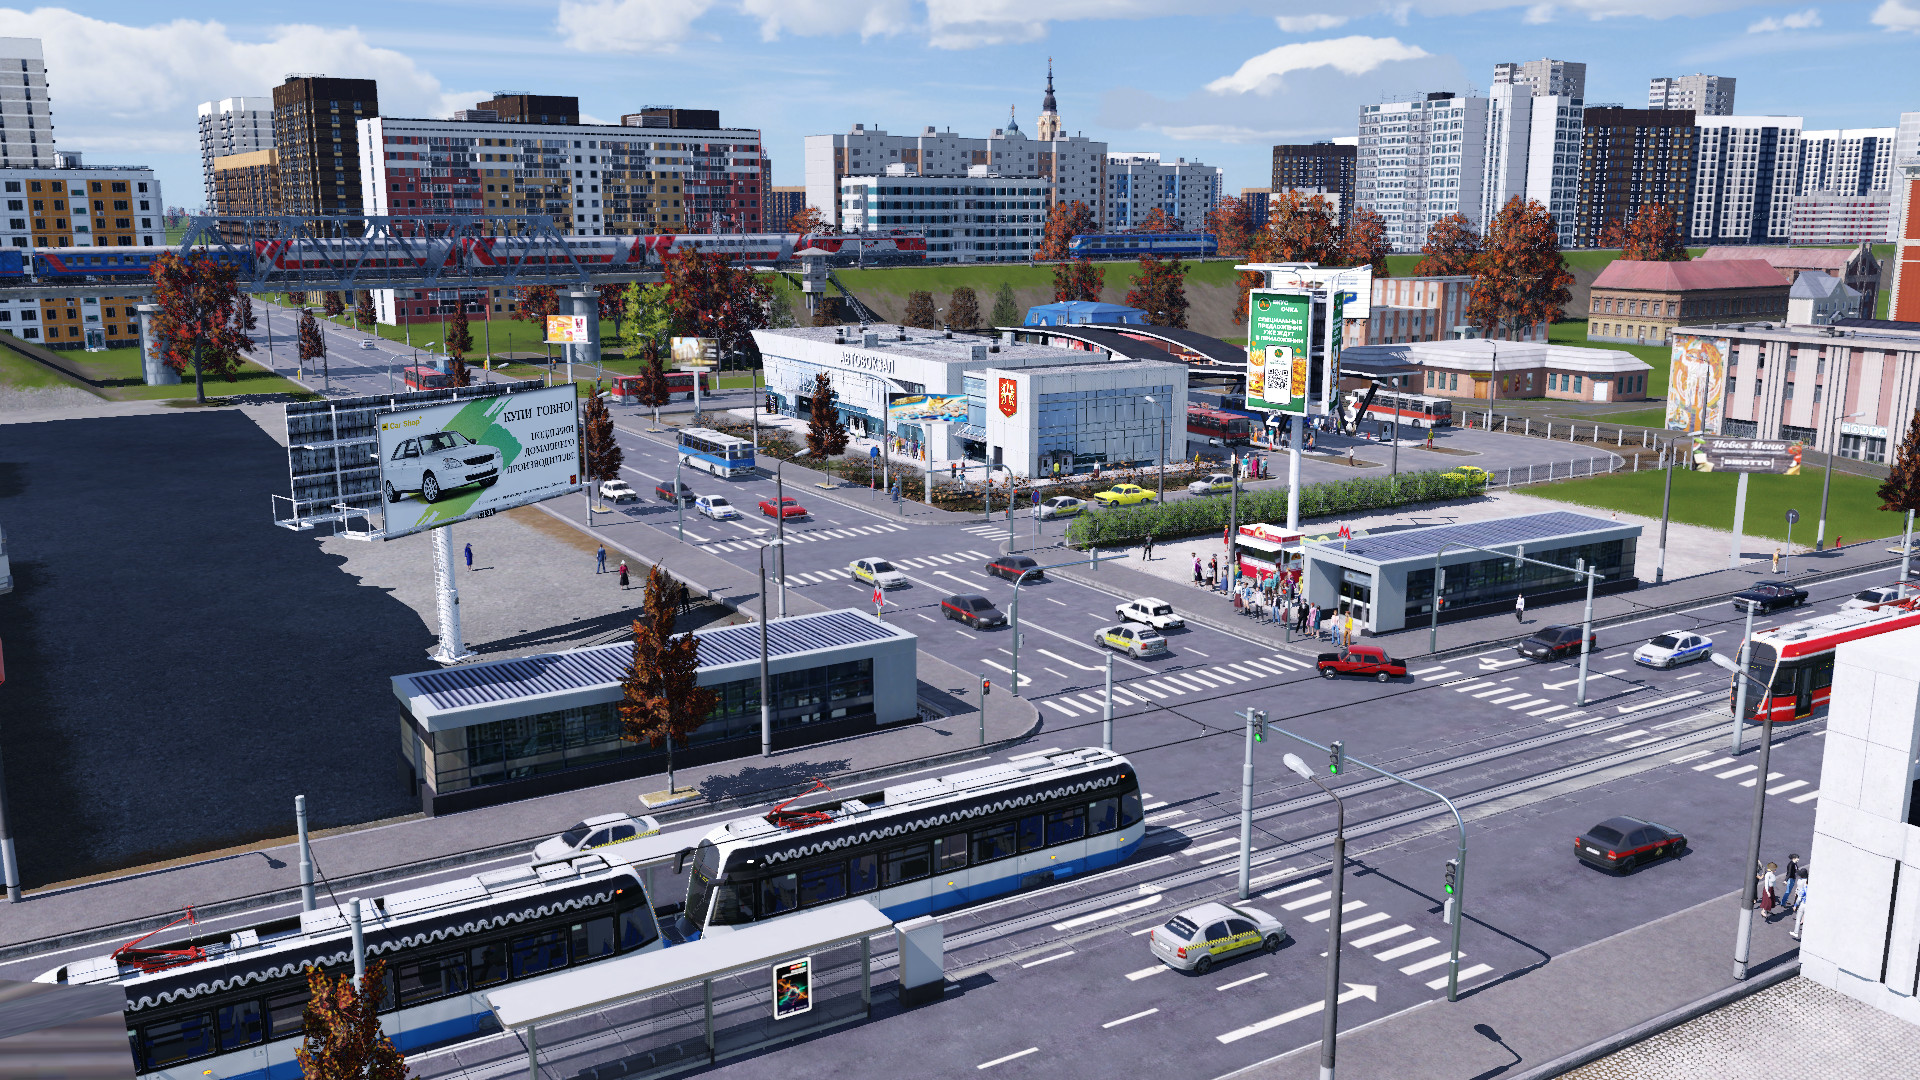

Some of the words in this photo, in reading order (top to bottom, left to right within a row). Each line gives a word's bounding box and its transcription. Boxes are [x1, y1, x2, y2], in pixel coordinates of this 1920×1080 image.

[1257, 316, 1303, 325] СПЕЦИАЛЬНЫЕ
[1257, 322, 1303, 332] ПРЕДЛОЖЕНИЯ
[840, 351, 895, 375] АВТОВОКЗАЛ
[503, 407, 533, 423] КУПИ
[536, 400, 573, 417] ГОВНО!
[1344, 396, 1357, 422] 3
[389, 421, 401, 430] Car
[1843, 424, 1886, 436] ПОЧТА
[1712, 440, 1749, 449] Новое
[1750, 441, 1787, 450] Меню
